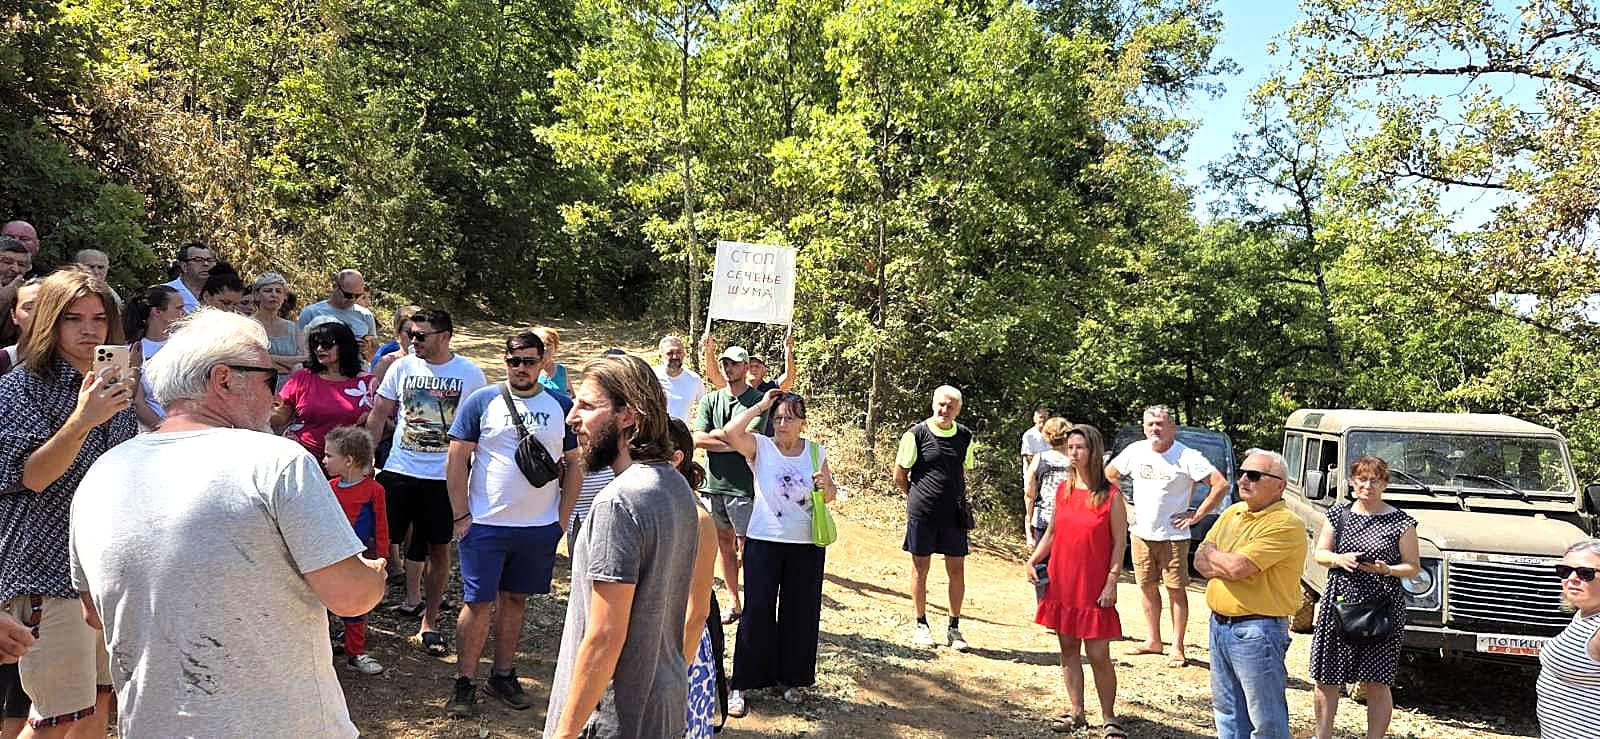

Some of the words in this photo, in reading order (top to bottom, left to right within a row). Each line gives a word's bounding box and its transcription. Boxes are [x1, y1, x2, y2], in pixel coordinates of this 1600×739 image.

[731, 250, 775, 264] СТОП
[727, 270, 783, 284] СЕЧЕЊЕ
[728, 285, 773, 298] ШУМА
[504, 412, 550, 426] TMMY
